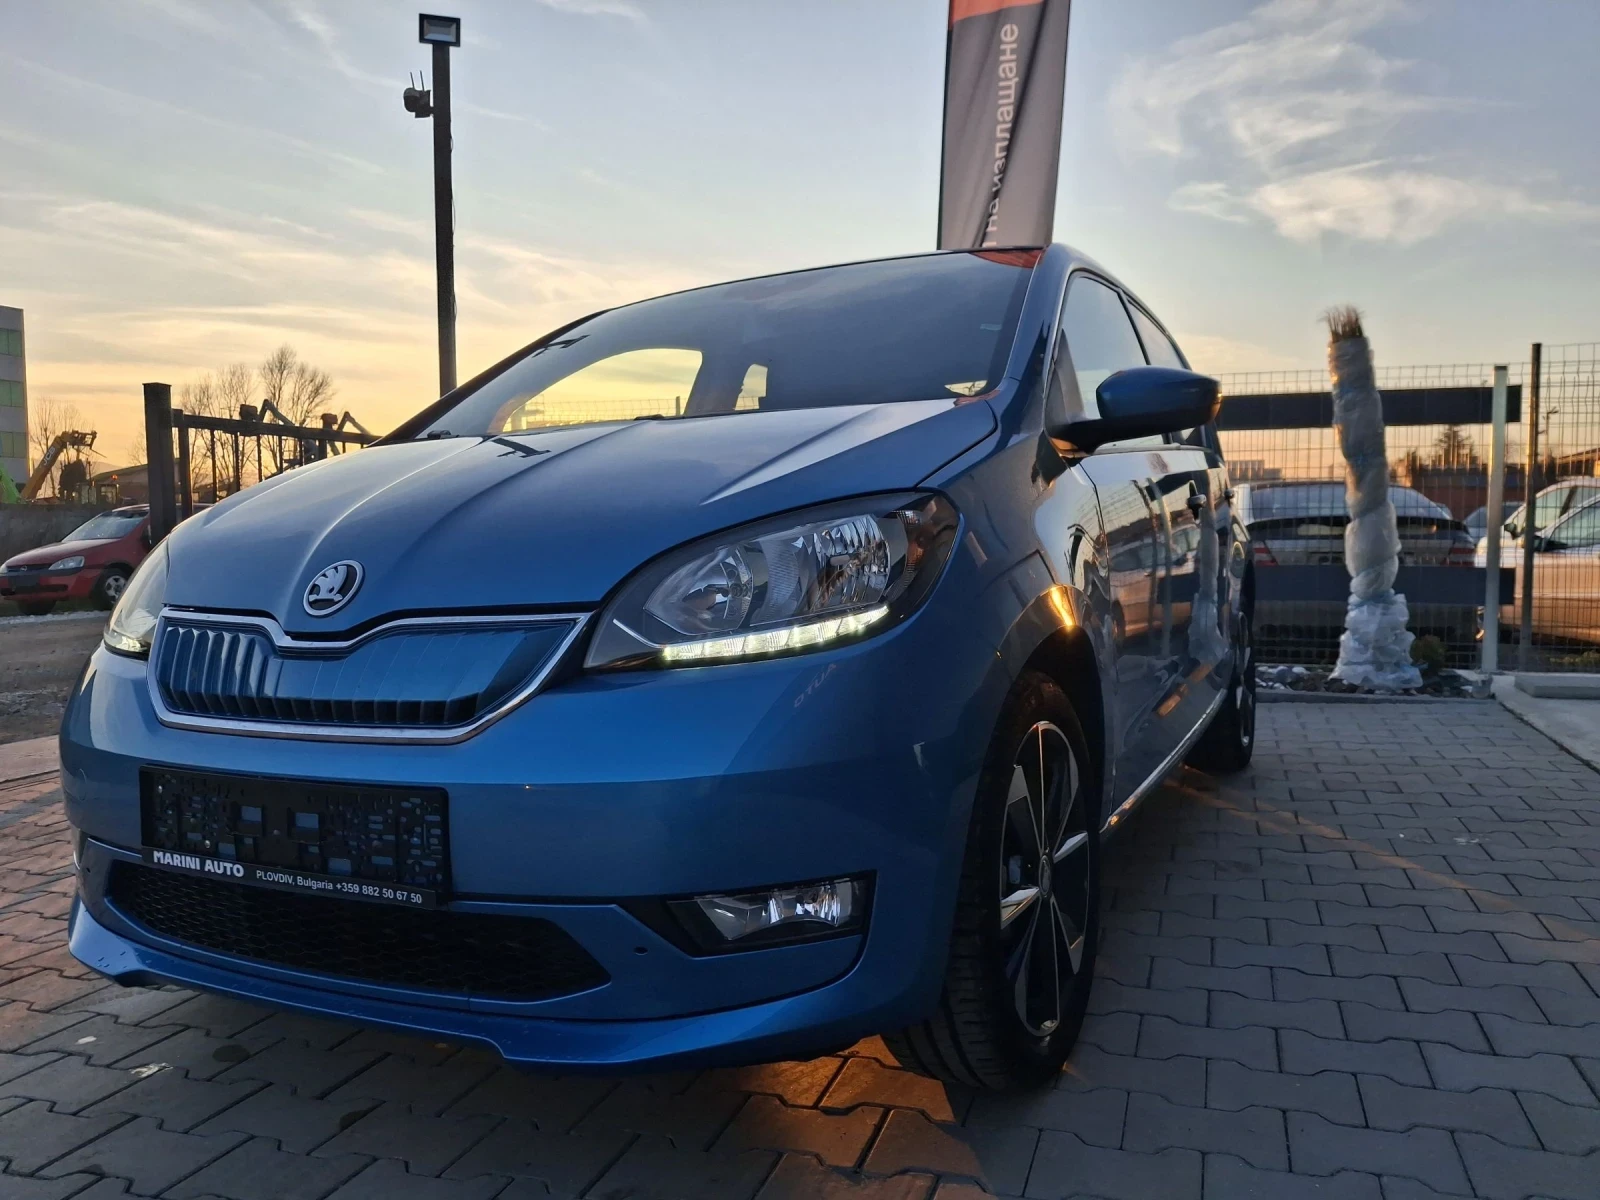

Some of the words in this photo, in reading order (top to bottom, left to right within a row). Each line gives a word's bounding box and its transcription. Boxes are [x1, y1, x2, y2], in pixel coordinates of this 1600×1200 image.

[992, 22, 1019, 192] изплащане
[43, 446, 56, 466] JCB
[153, 850, 201, 870] MARINI
[204, 859, 245, 878] AUTO
[256, 869, 295, 885] PLOVDIV,
[297, 876, 333, 890] Bulgaria
[335, 882, 360, 894] +359
[362, 885, 380, 897] 882
[382, 888, 394, 899] 50
[396, 890, 408, 902] 67
[410, 893, 423, 904] 50
